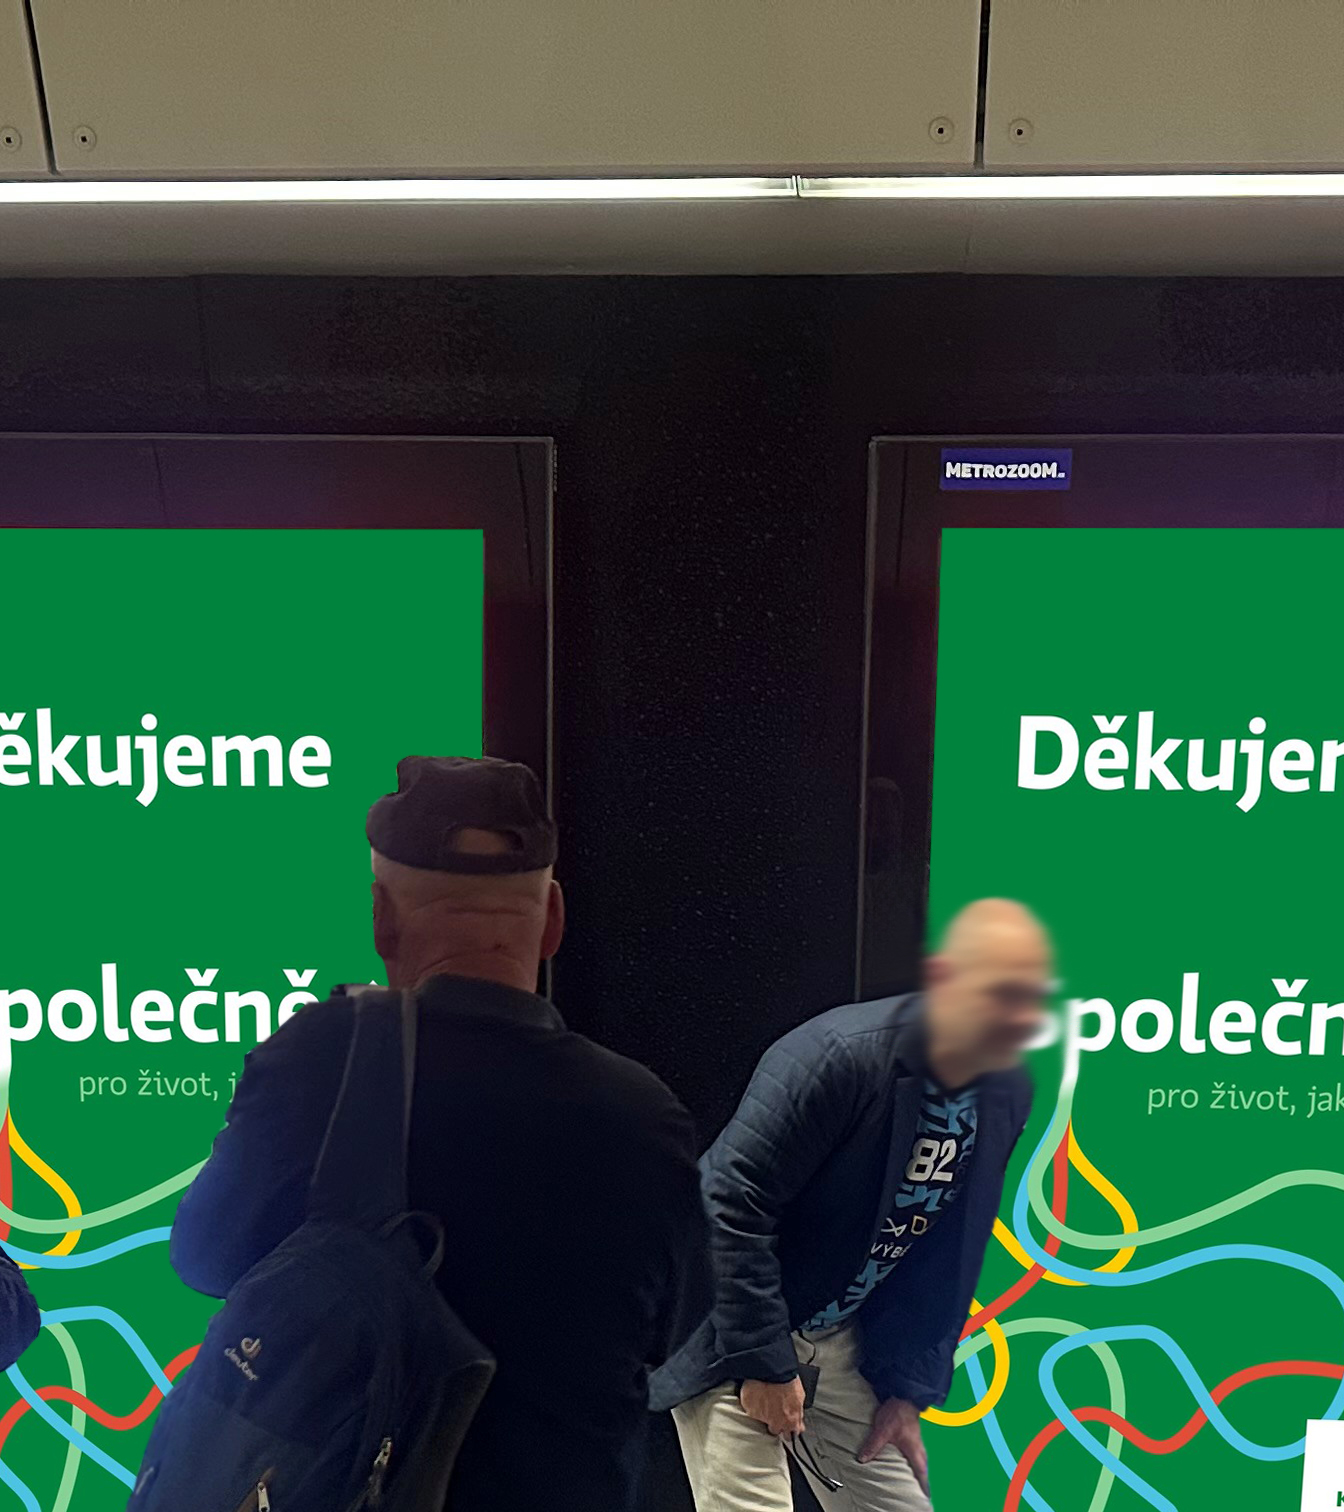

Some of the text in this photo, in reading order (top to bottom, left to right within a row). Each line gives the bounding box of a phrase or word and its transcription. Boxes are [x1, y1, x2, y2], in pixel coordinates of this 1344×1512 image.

[80, 1076, 127, 1102] pro
[138, 1069, 218, 1101] život,
[1148, 1088, 1199, 1115] pro
[1210, 1082, 1295, 1116] život,
[906, 1137, 956, 1182] 82
